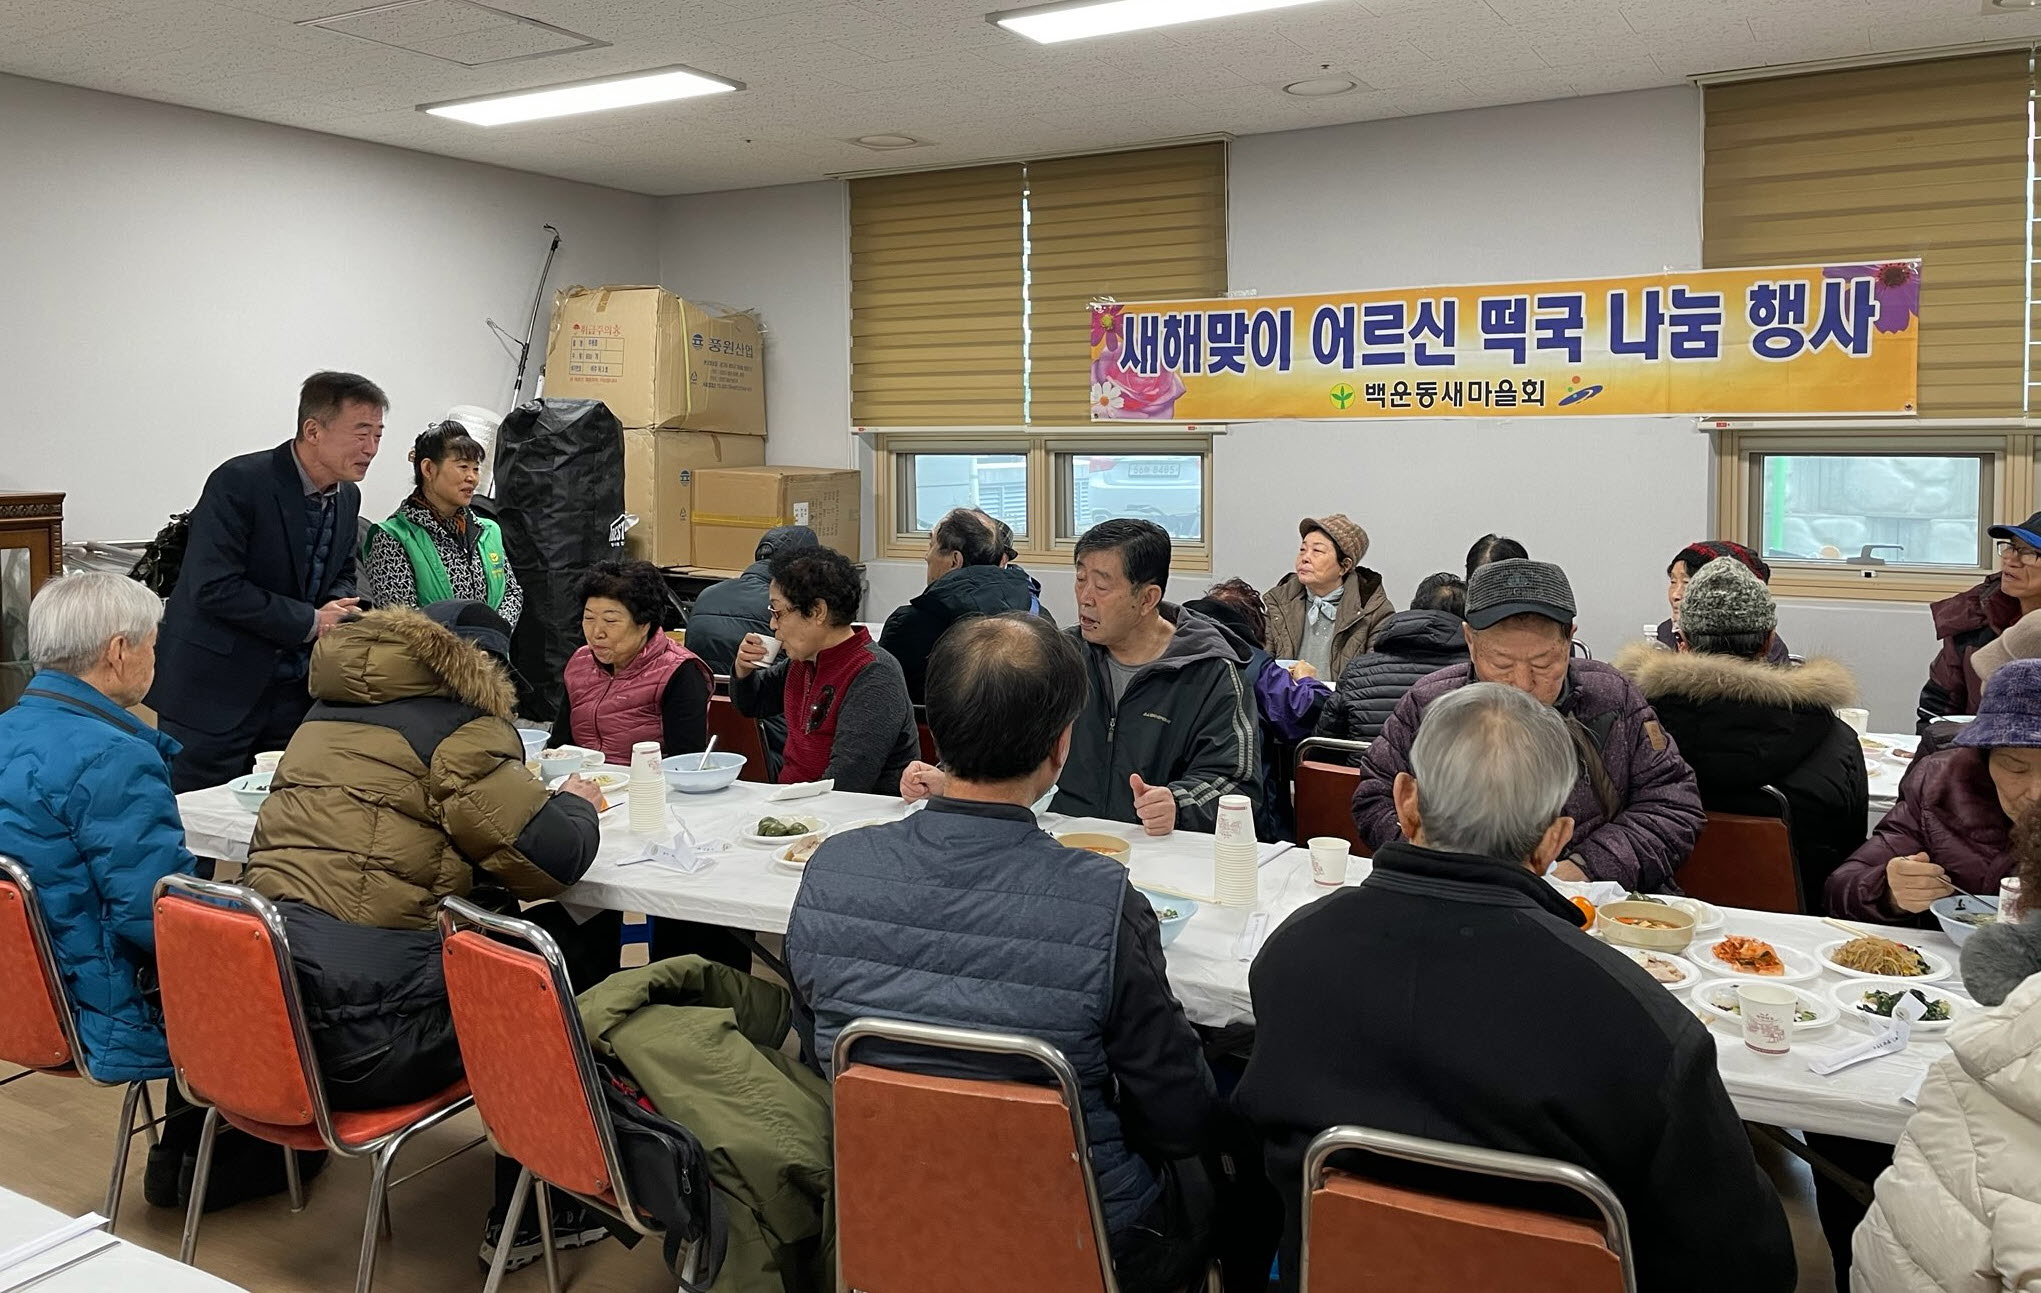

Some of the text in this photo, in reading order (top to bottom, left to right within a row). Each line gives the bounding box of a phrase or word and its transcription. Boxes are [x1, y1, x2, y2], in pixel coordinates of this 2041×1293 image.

[1119, 280, 1876, 375] 새해맞이 어르신 떡국 나눔 행사
[708, 337, 753, 358] 풍원산업
[1365, 379, 1545, 408] 백운동새마을회
